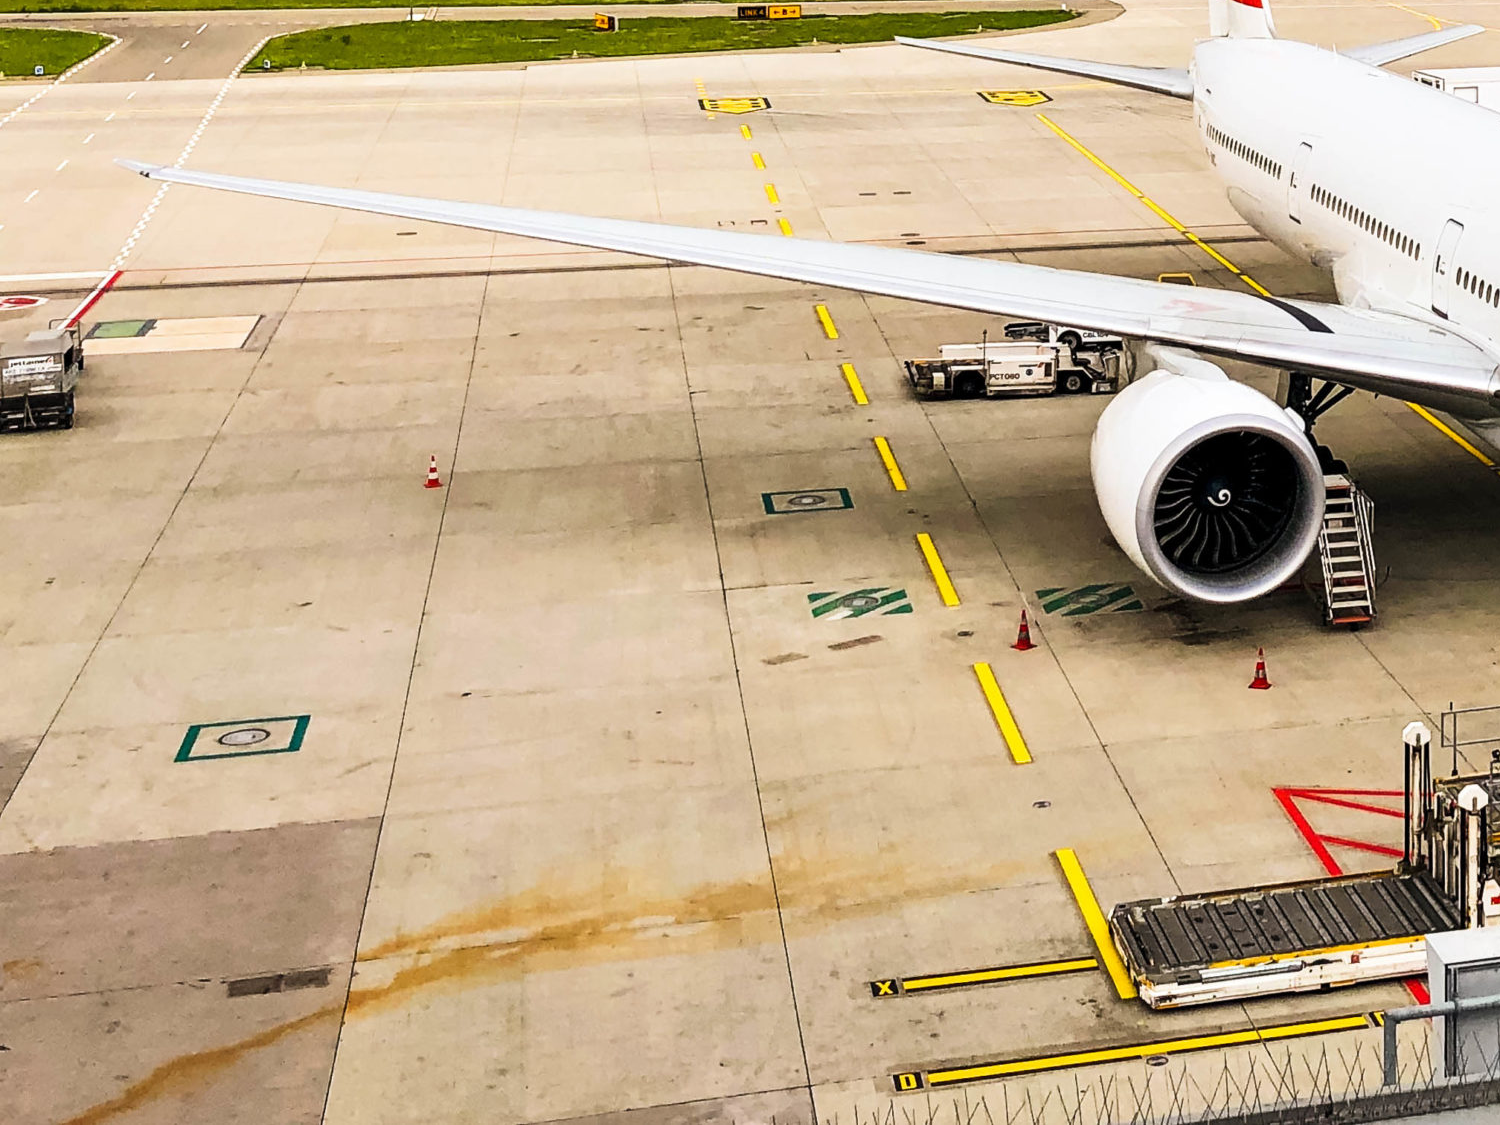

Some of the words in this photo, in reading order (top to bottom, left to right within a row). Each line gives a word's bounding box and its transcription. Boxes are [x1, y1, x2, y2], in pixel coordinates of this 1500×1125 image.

[740, 9, 757, 17] LINK
[875, 979, 894, 996] X
[898, 1072, 917, 1090] D
